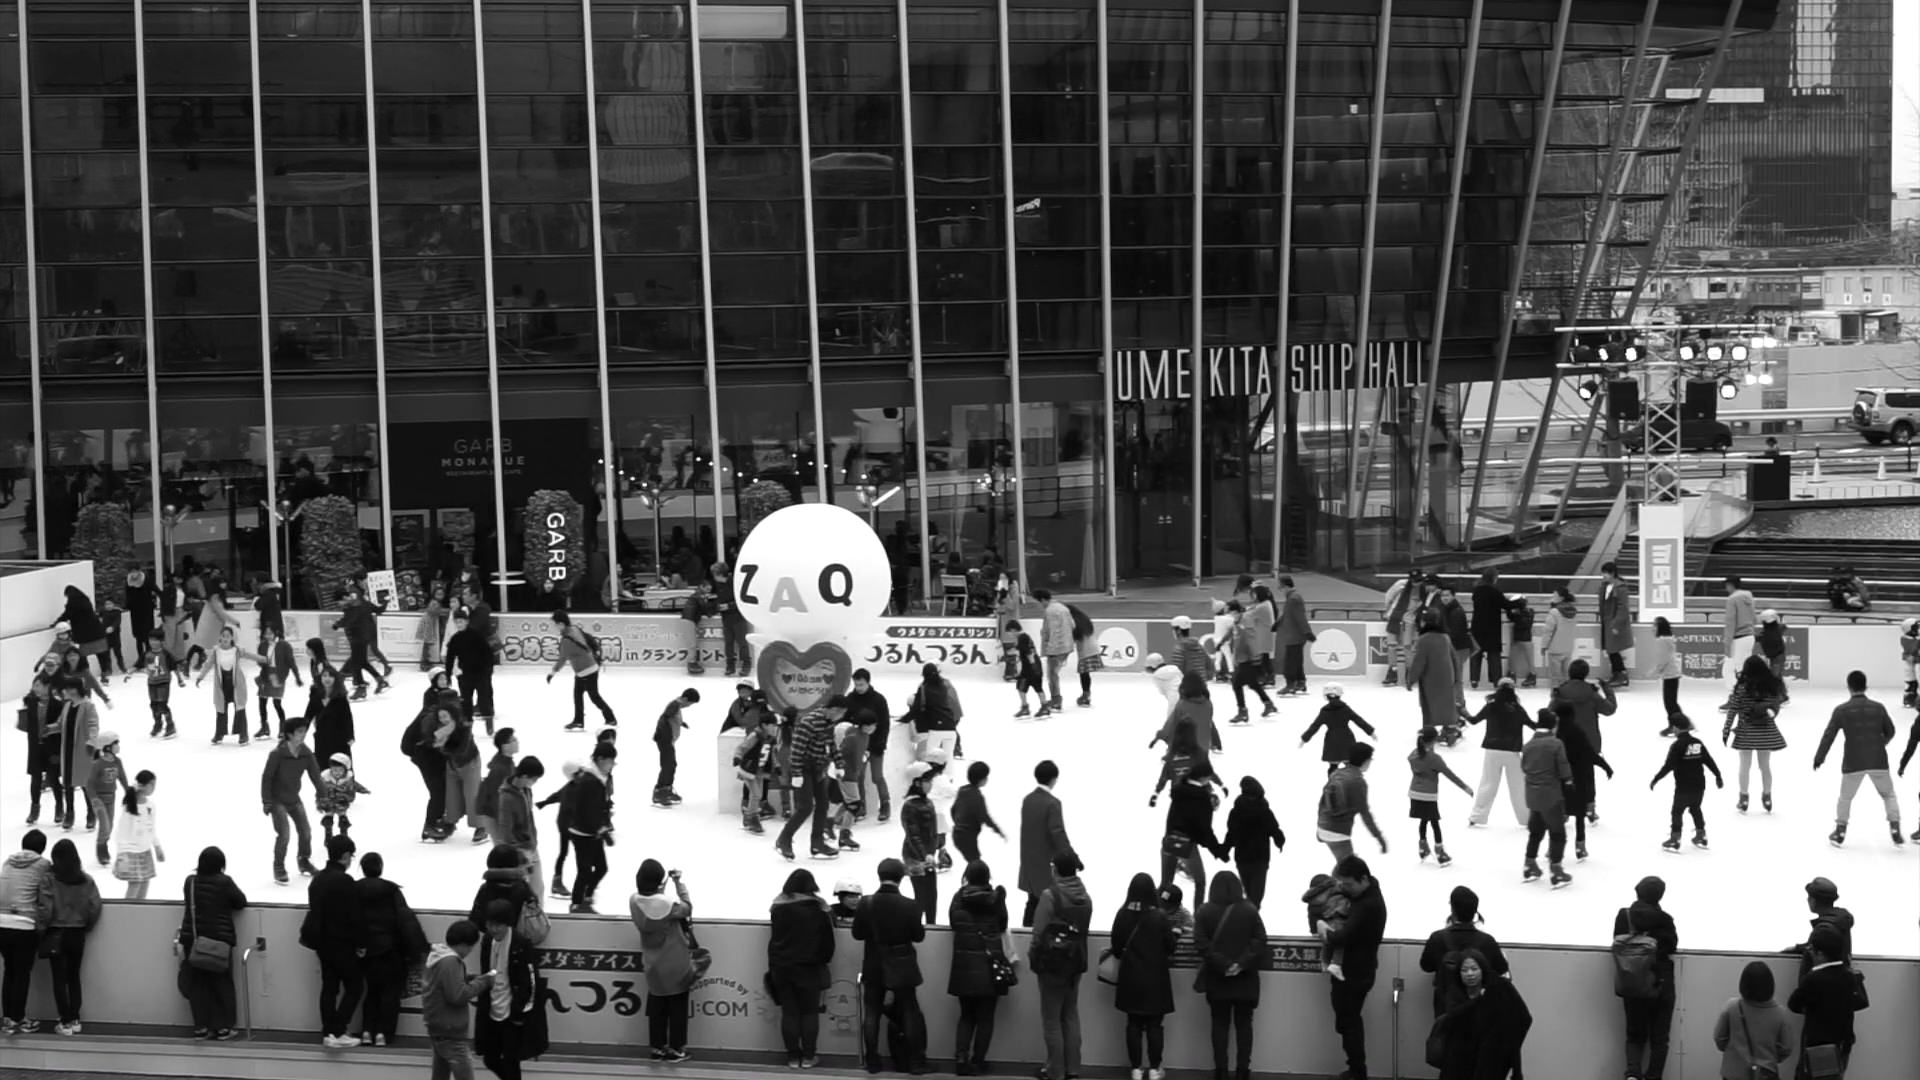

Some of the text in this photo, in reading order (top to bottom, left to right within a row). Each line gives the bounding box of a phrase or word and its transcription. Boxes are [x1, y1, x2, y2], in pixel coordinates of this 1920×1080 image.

[1291, 343, 1353, 393] SHIP
[1369, 340, 1428, 388] HALL
[441, 456, 526, 467] MONAUE
[546, 512, 567, 581] GARB
[740, 563, 854, 613] ZAQ
[625, 649, 639, 661] in
[864, 643, 991, 665] つるんつるん
[1099, 645, 1135, 660] ZAQ
